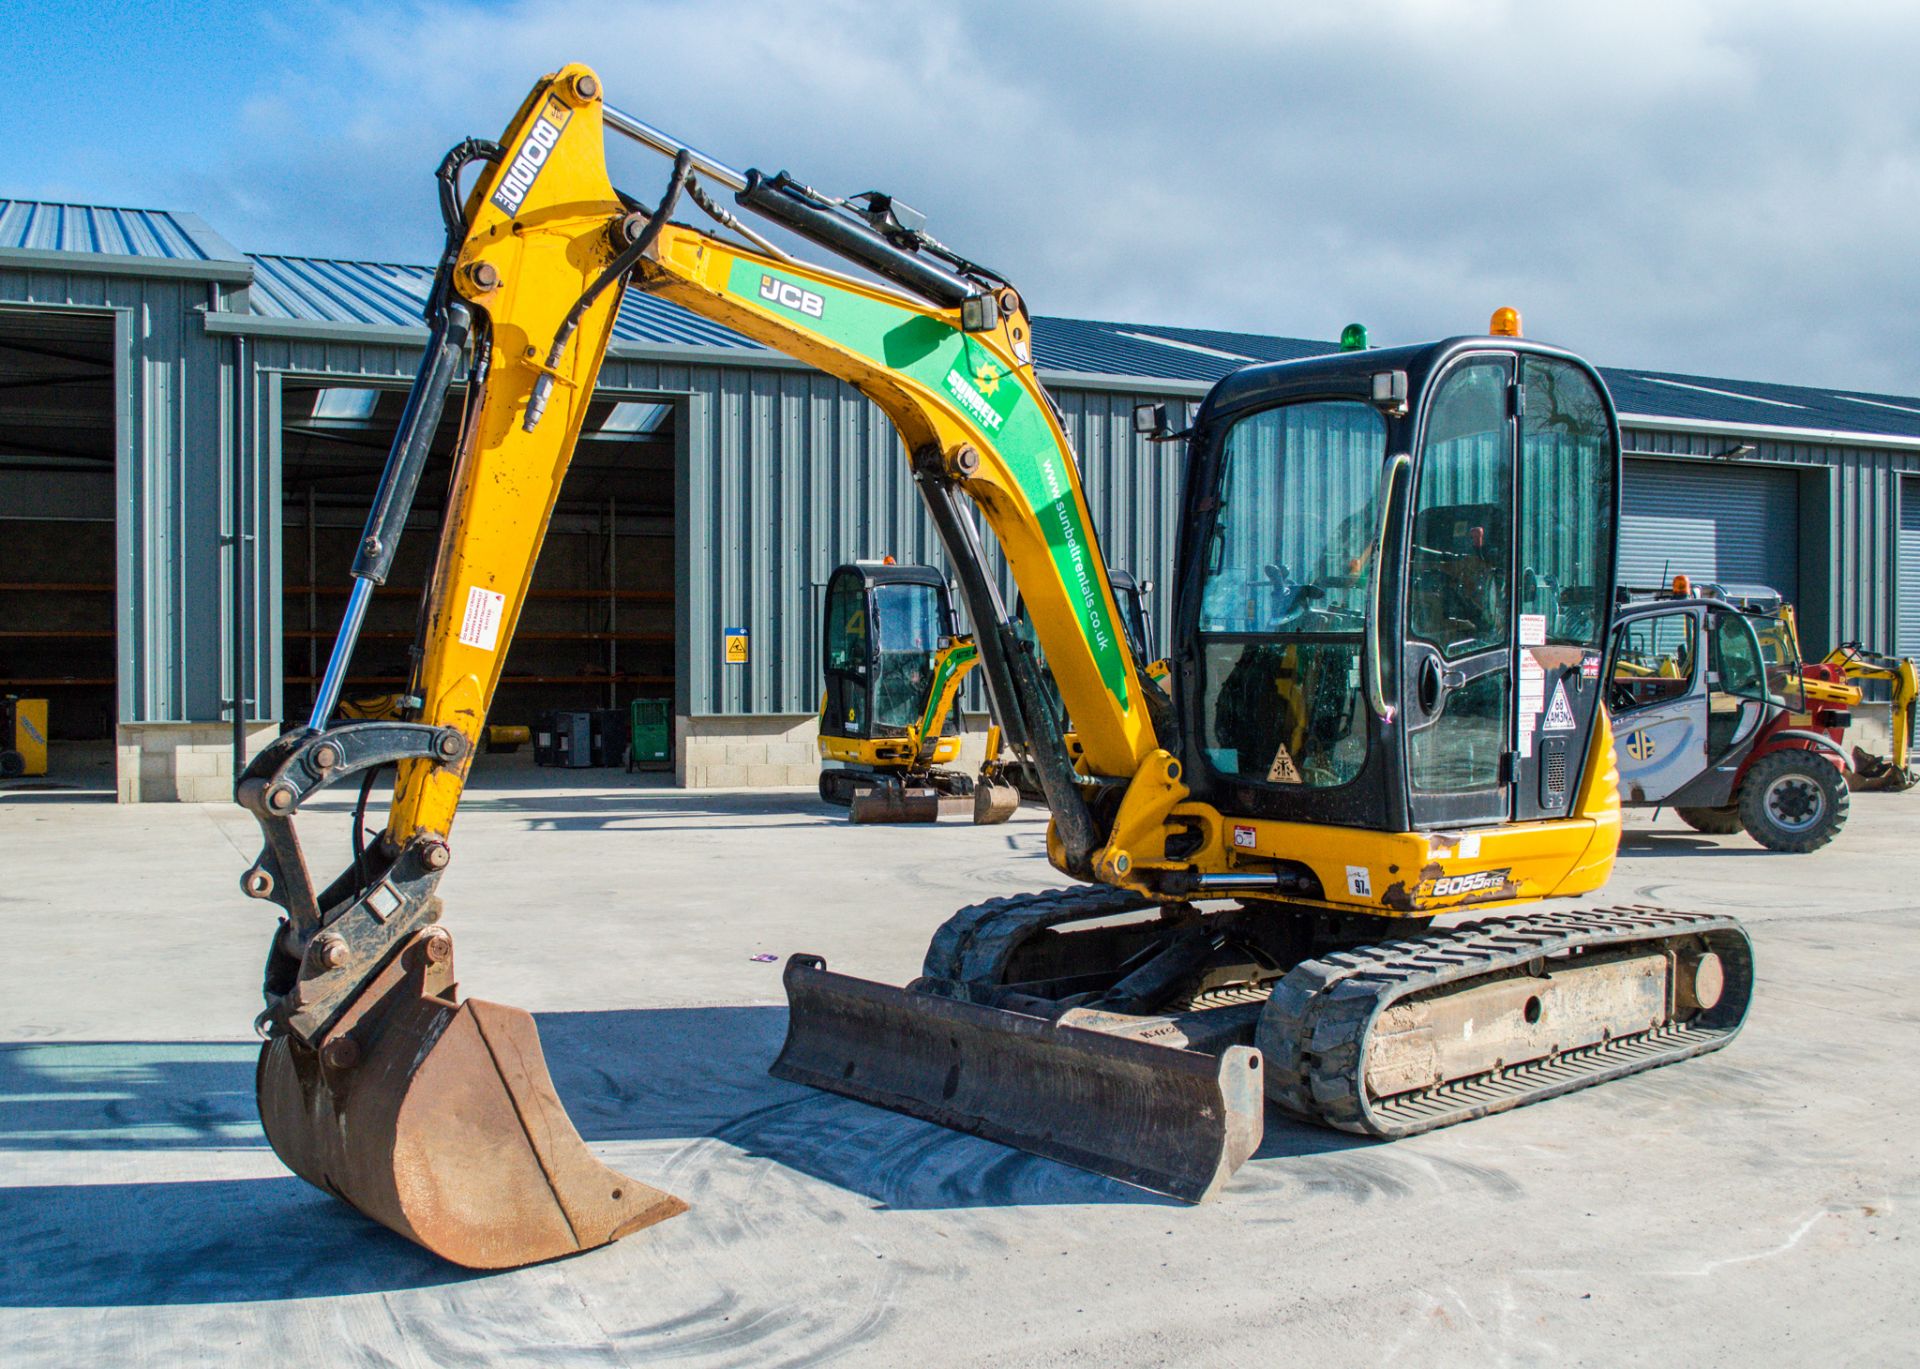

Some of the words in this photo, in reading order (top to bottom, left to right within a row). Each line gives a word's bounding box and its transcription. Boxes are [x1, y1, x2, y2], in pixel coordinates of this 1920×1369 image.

[500, 118, 559, 204] 8055
[495, 191, 517, 212] RTS
[760, 276, 824, 317] JCB
[947, 369, 1003, 431] SUNBELT
[951, 388, 989, 428] RENTALS
[1043, 458, 1109, 651] www.sunbeltrentals.co.uk
